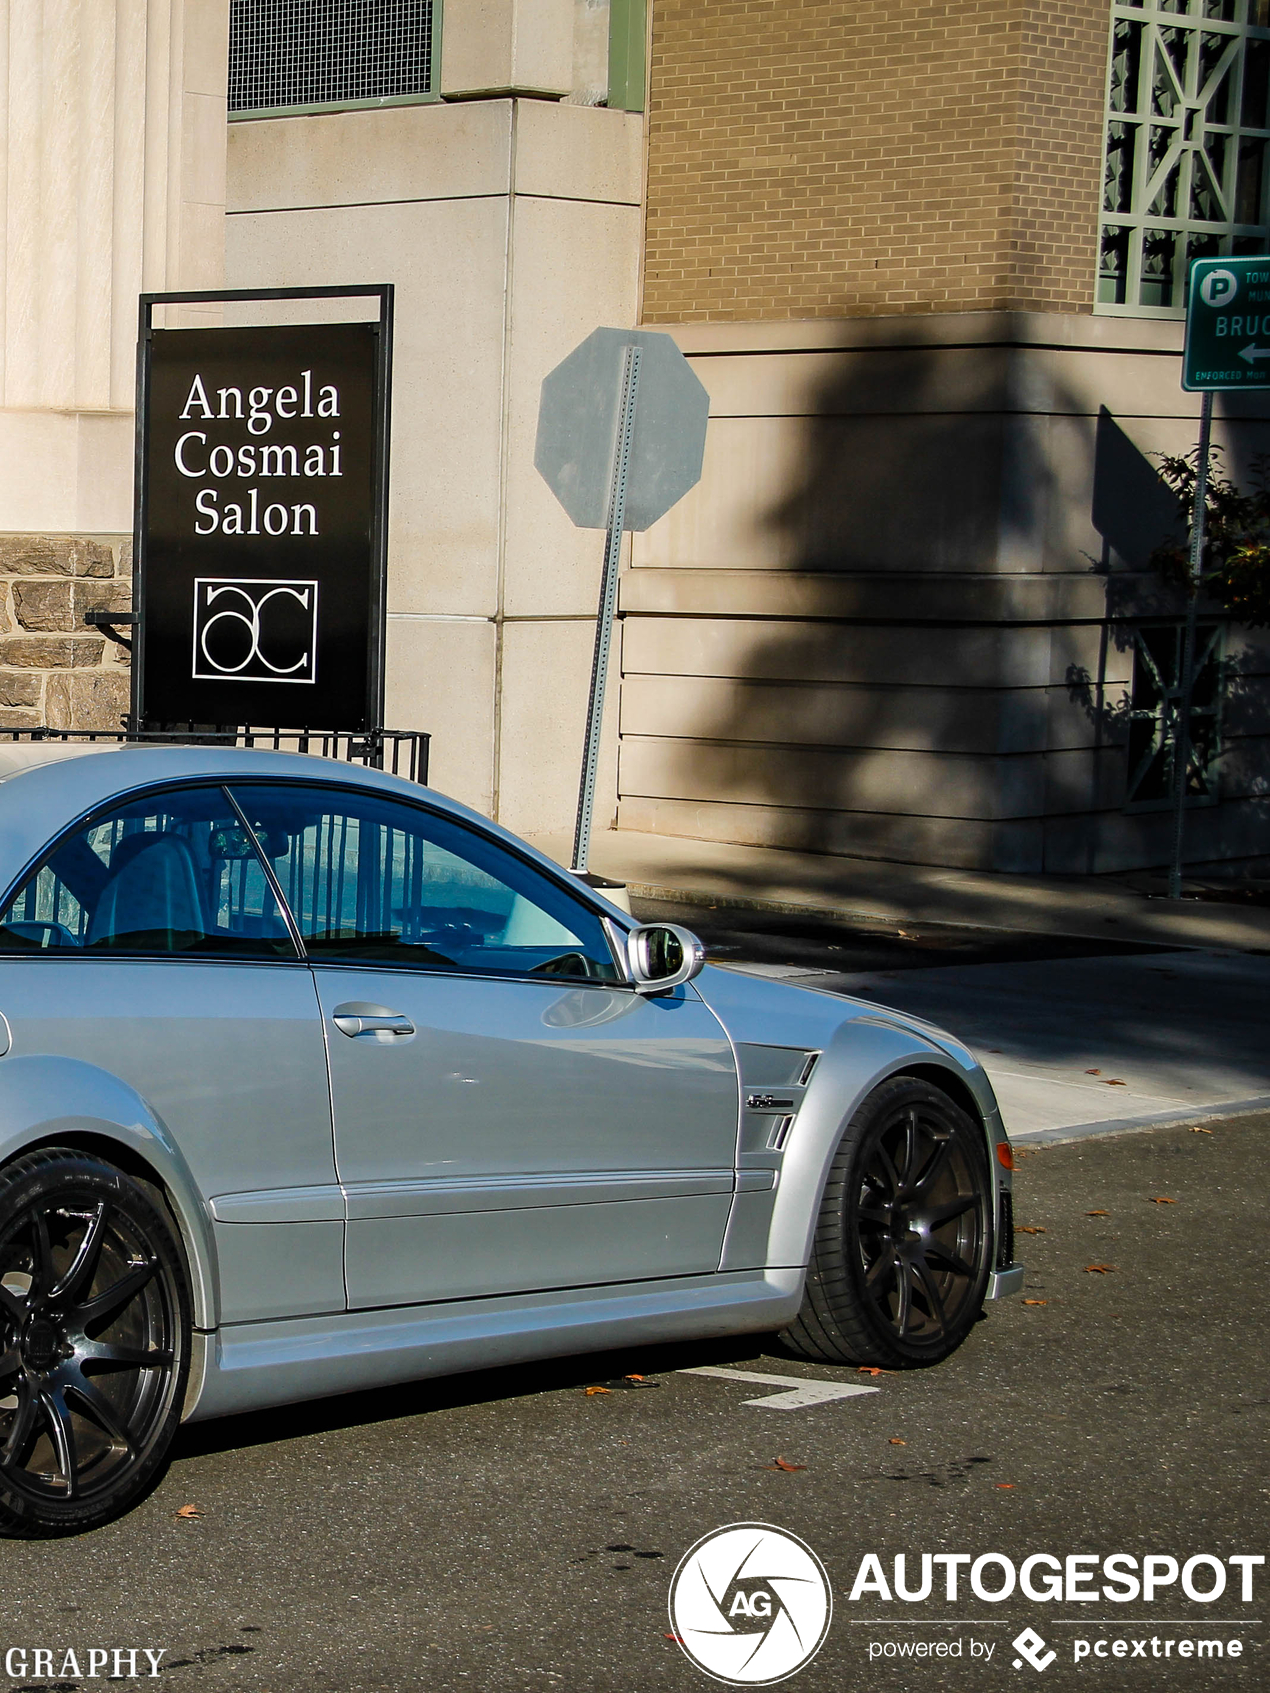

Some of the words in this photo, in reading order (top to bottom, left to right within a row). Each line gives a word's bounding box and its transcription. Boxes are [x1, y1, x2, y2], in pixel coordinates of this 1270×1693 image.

[1210, 278, 1230, 300] P
[1195, 371, 1242, 381] ENFORCED
[179, 370, 340, 435] Angela
[175, 431, 343, 478] Cosmai
[195, 488, 319, 536] Salon
